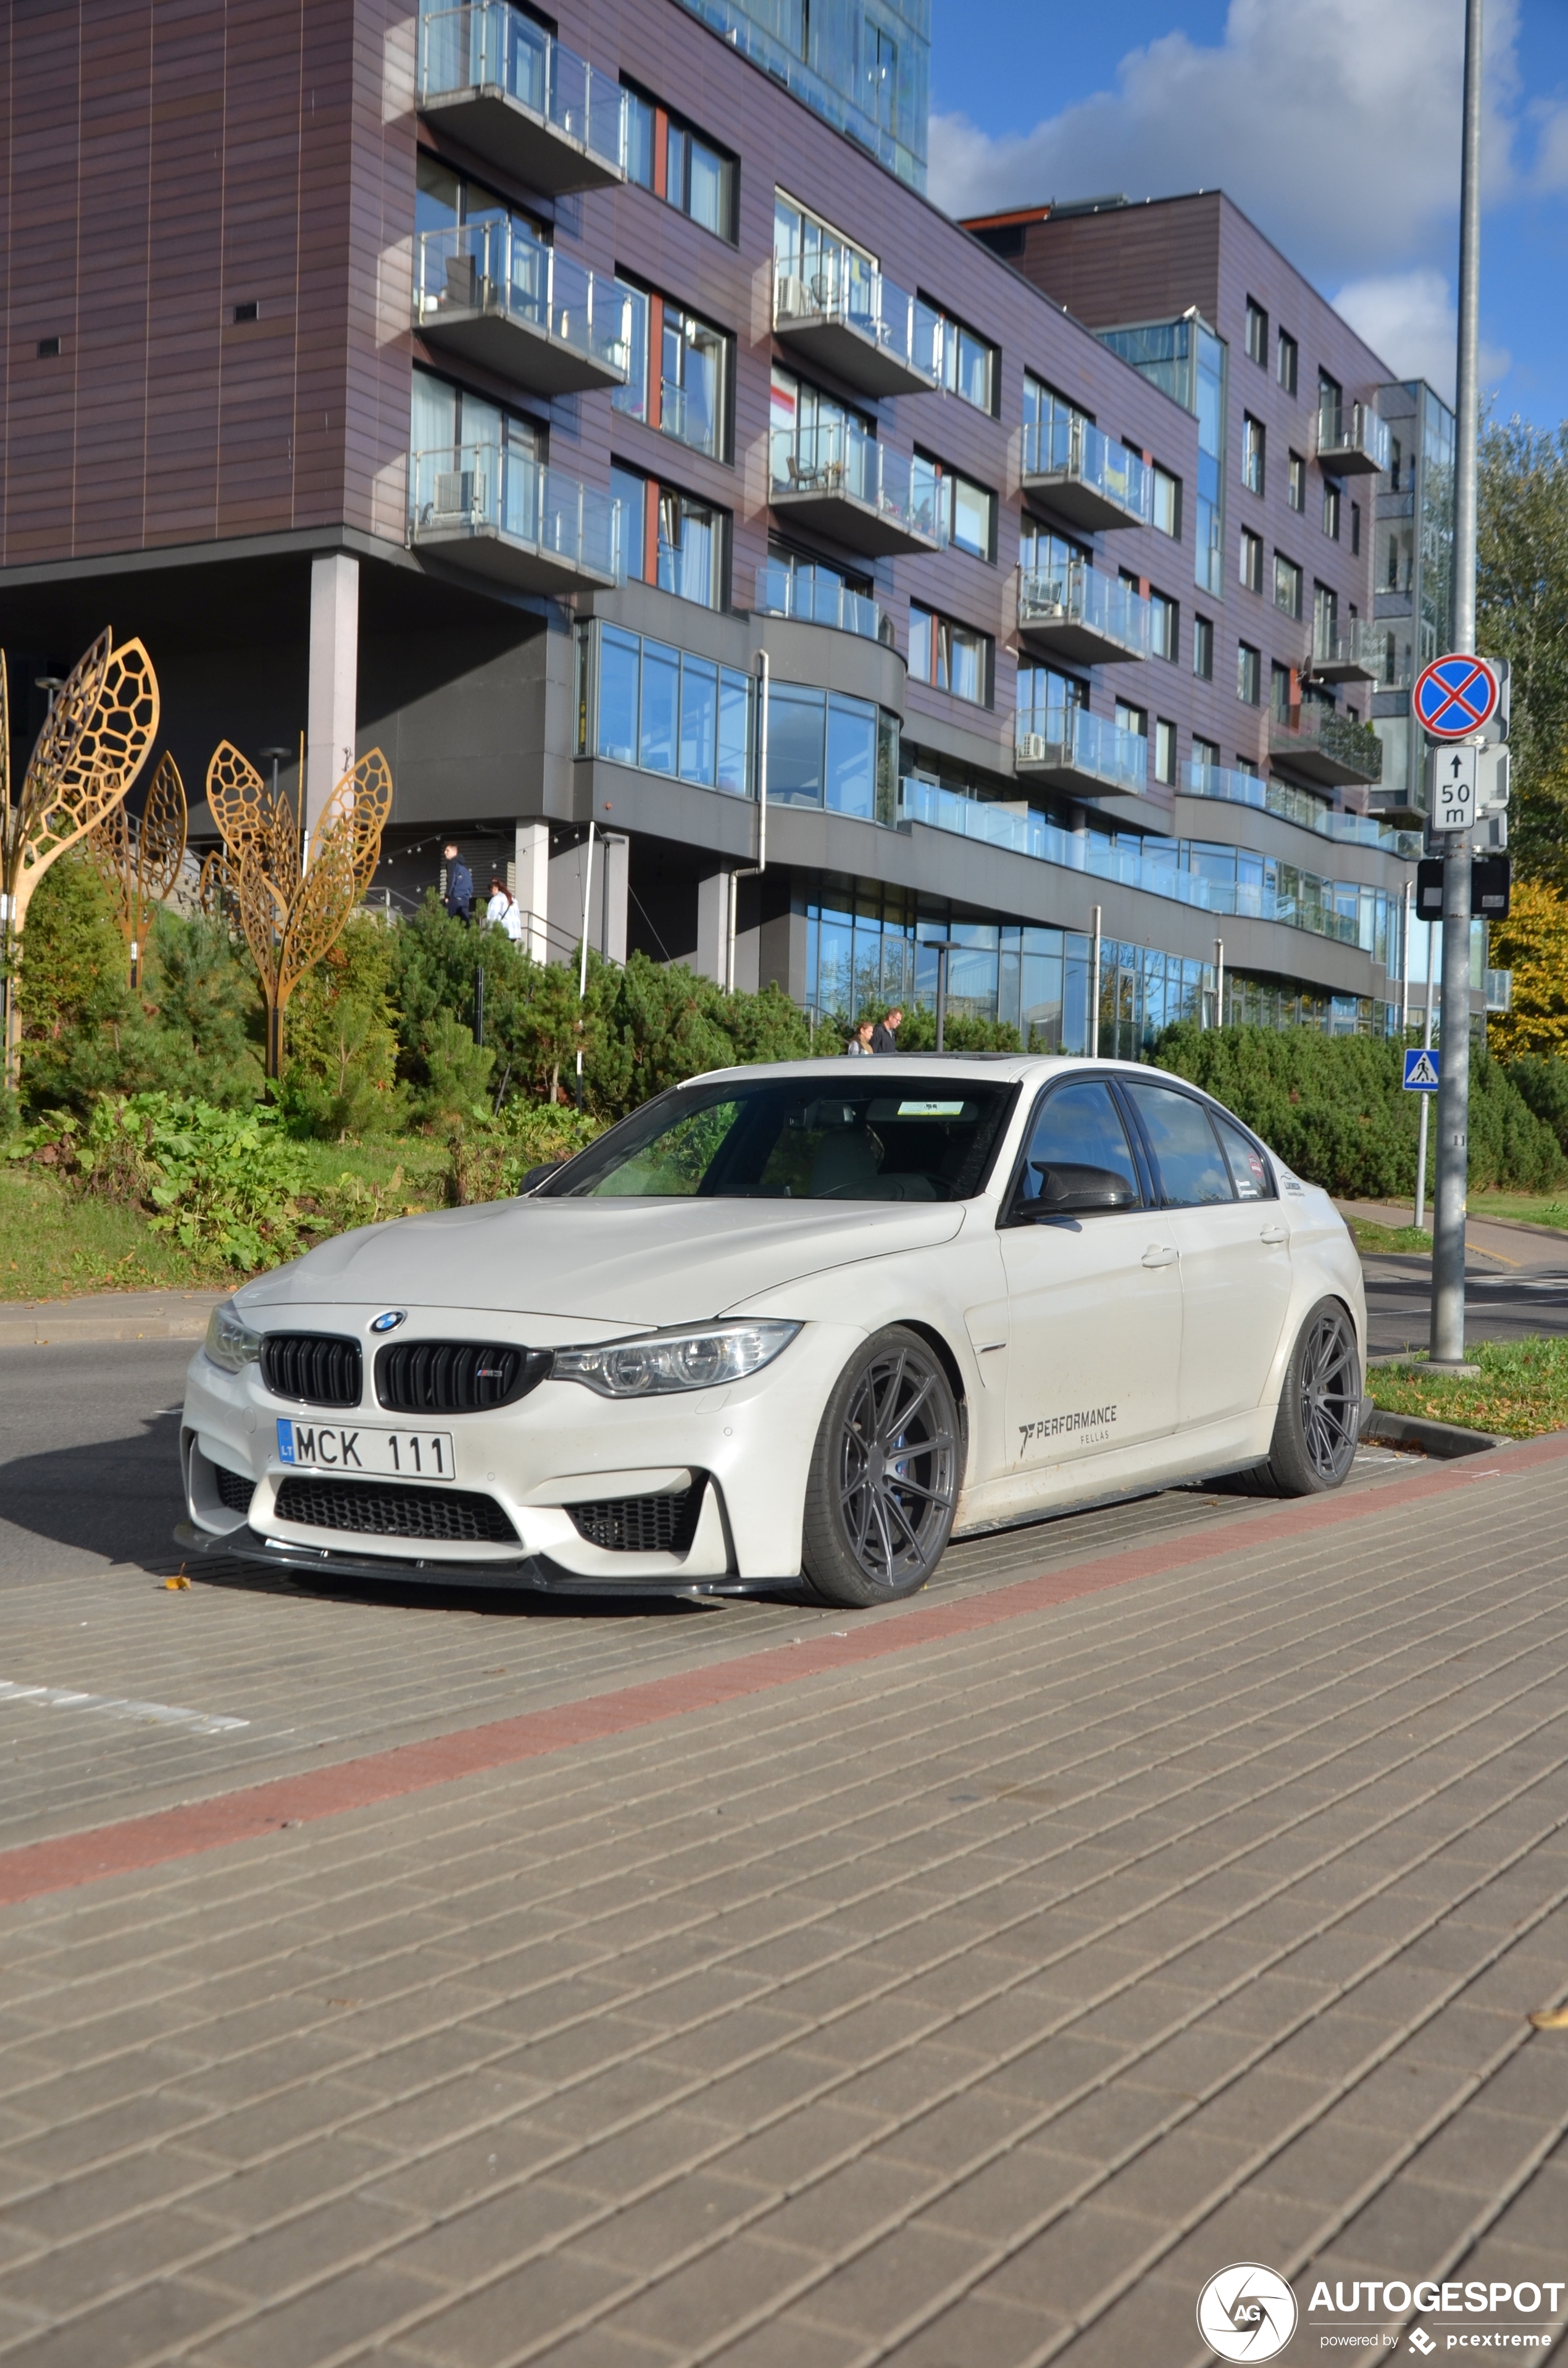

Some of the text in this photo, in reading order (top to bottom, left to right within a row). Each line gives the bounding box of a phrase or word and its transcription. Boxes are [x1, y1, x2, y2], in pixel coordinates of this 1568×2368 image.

[1441, 784, 1470, 803] 50
[1446, 809, 1464, 822] m
[1037, 1405, 1117, 1439] PERFORMANCE
[1081, 1431, 1109, 1444] FELLAS
[281, 1445, 292, 1455] LT
[296, 1425, 443, 1473] MCK 111
